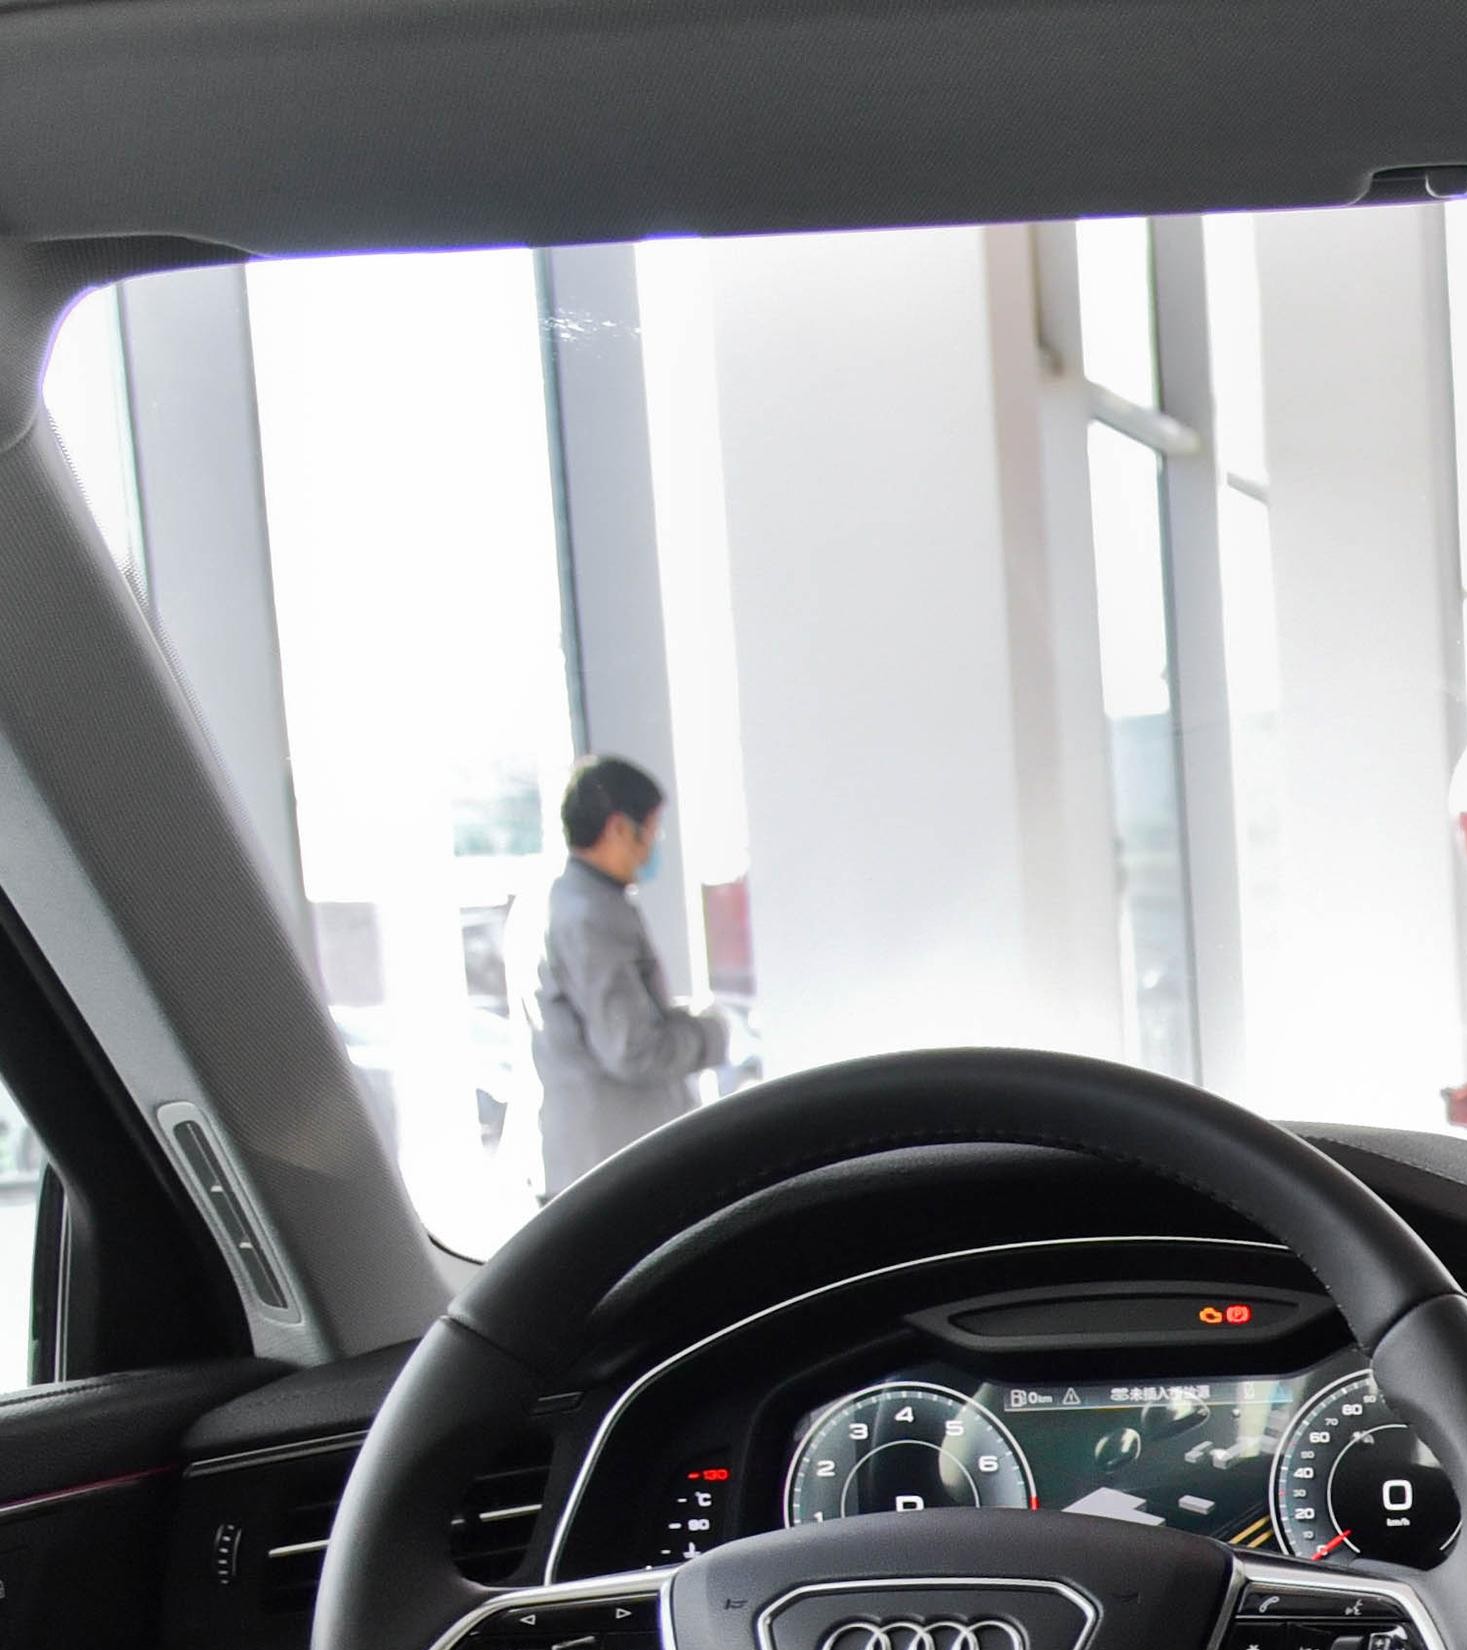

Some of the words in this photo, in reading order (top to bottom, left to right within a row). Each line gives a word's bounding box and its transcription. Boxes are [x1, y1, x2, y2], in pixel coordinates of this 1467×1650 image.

[895, 1406, 914, 1423] 4
[1342, 1404, 1363, 1416] 80
[945, 1421, 964, 1437] 5
[1324, 1418, 1339, 1427] 70
[850, 1423, 869, 1440] 3
[1309, 1432, 1331, 1443] 60
[816, 1460, 836, 1478] 2
[978, 1456, 998, 1472] 6
[1293, 1467, 1314, 1479] 40
[1382, 1479, 1413, 1511] 0
[1294, 1508, 1315, 1520] 20
[1386, 1517, 1411, 1527] km/h
